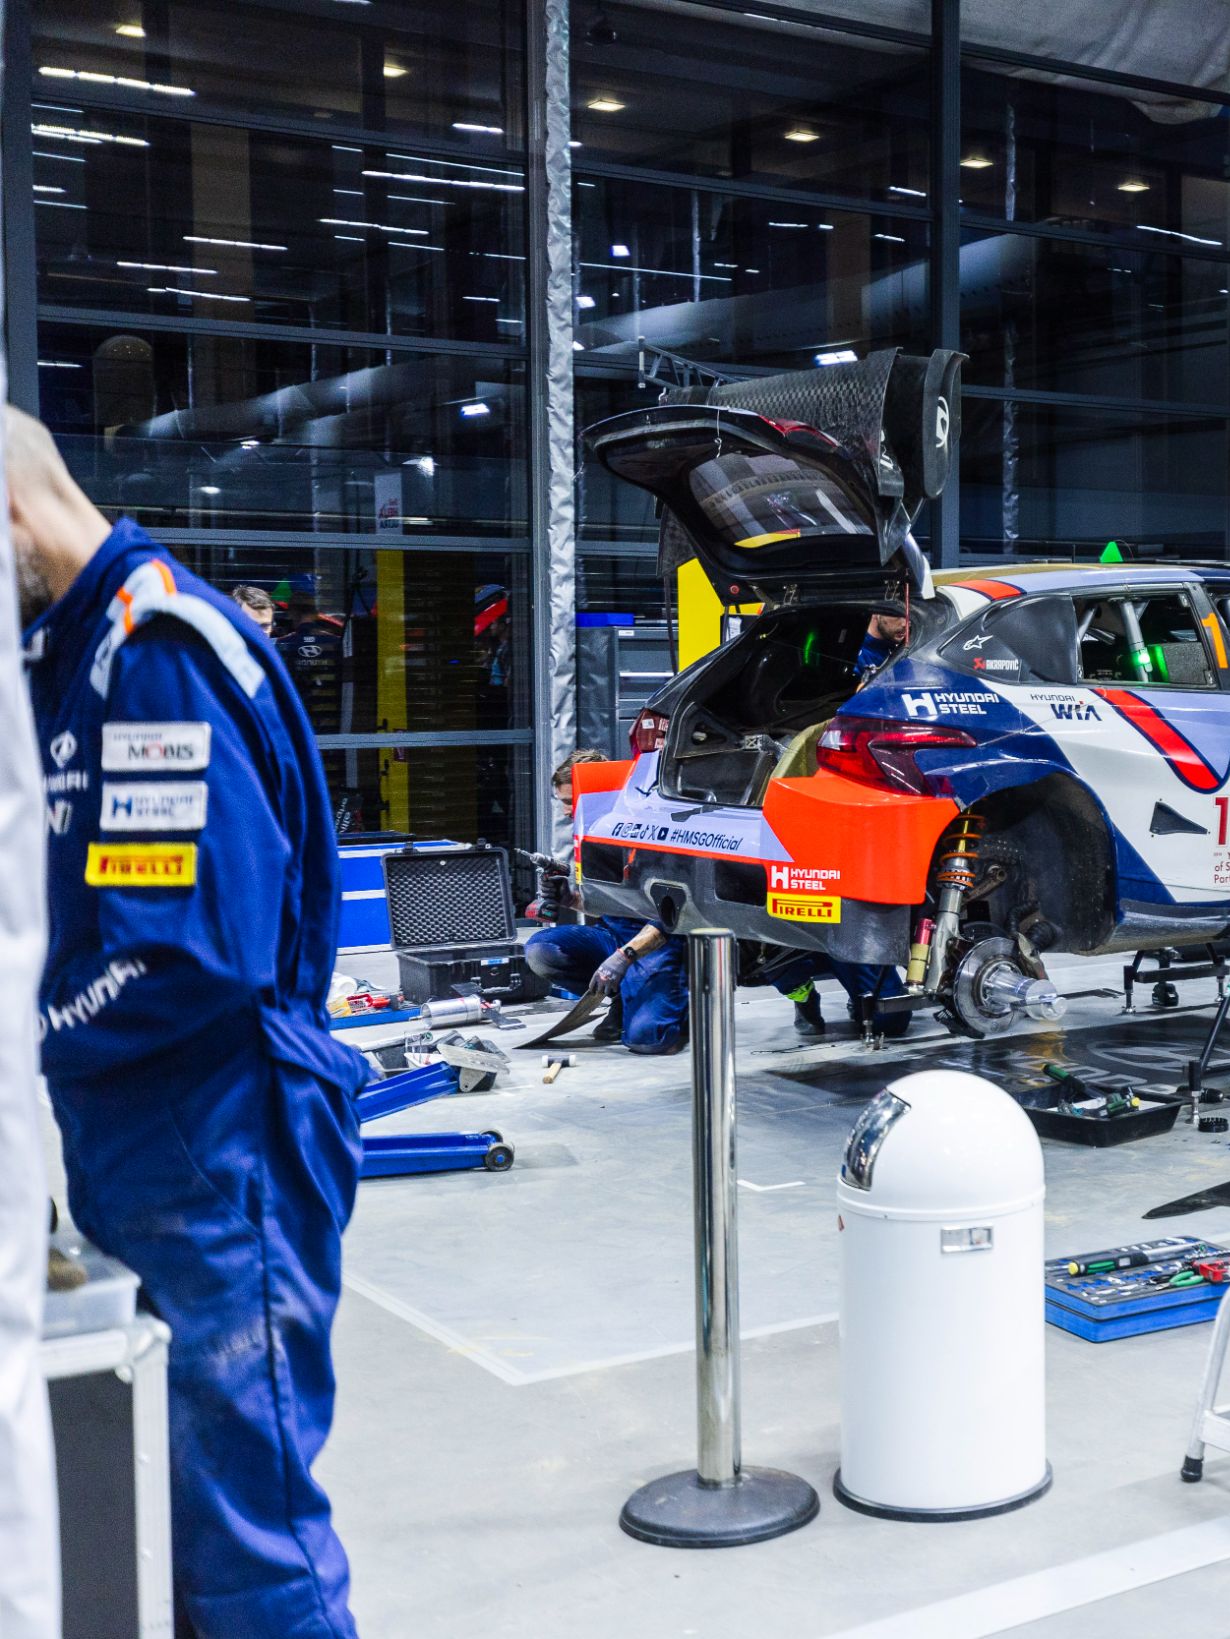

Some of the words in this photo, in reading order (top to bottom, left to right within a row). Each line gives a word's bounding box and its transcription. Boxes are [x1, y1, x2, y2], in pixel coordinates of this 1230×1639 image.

[936, 692, 999, 704] HYUNDAI
[1030, 693, 1075, 702] HYUNDAI
[938, 704, 987, 715] STEEL
[128, 742, 195, 761] MOBIS
[670, 828, 744, 851] #HMSGOfficial
[99, 855, 184, 875] PIRELLI
[1214, 861, 1223, 872] of
[790, 868, 841, 880] HYUNDAI
[790, 879, 827, 891] STEEL
[772, 898, 833, 918] PIRELLI
